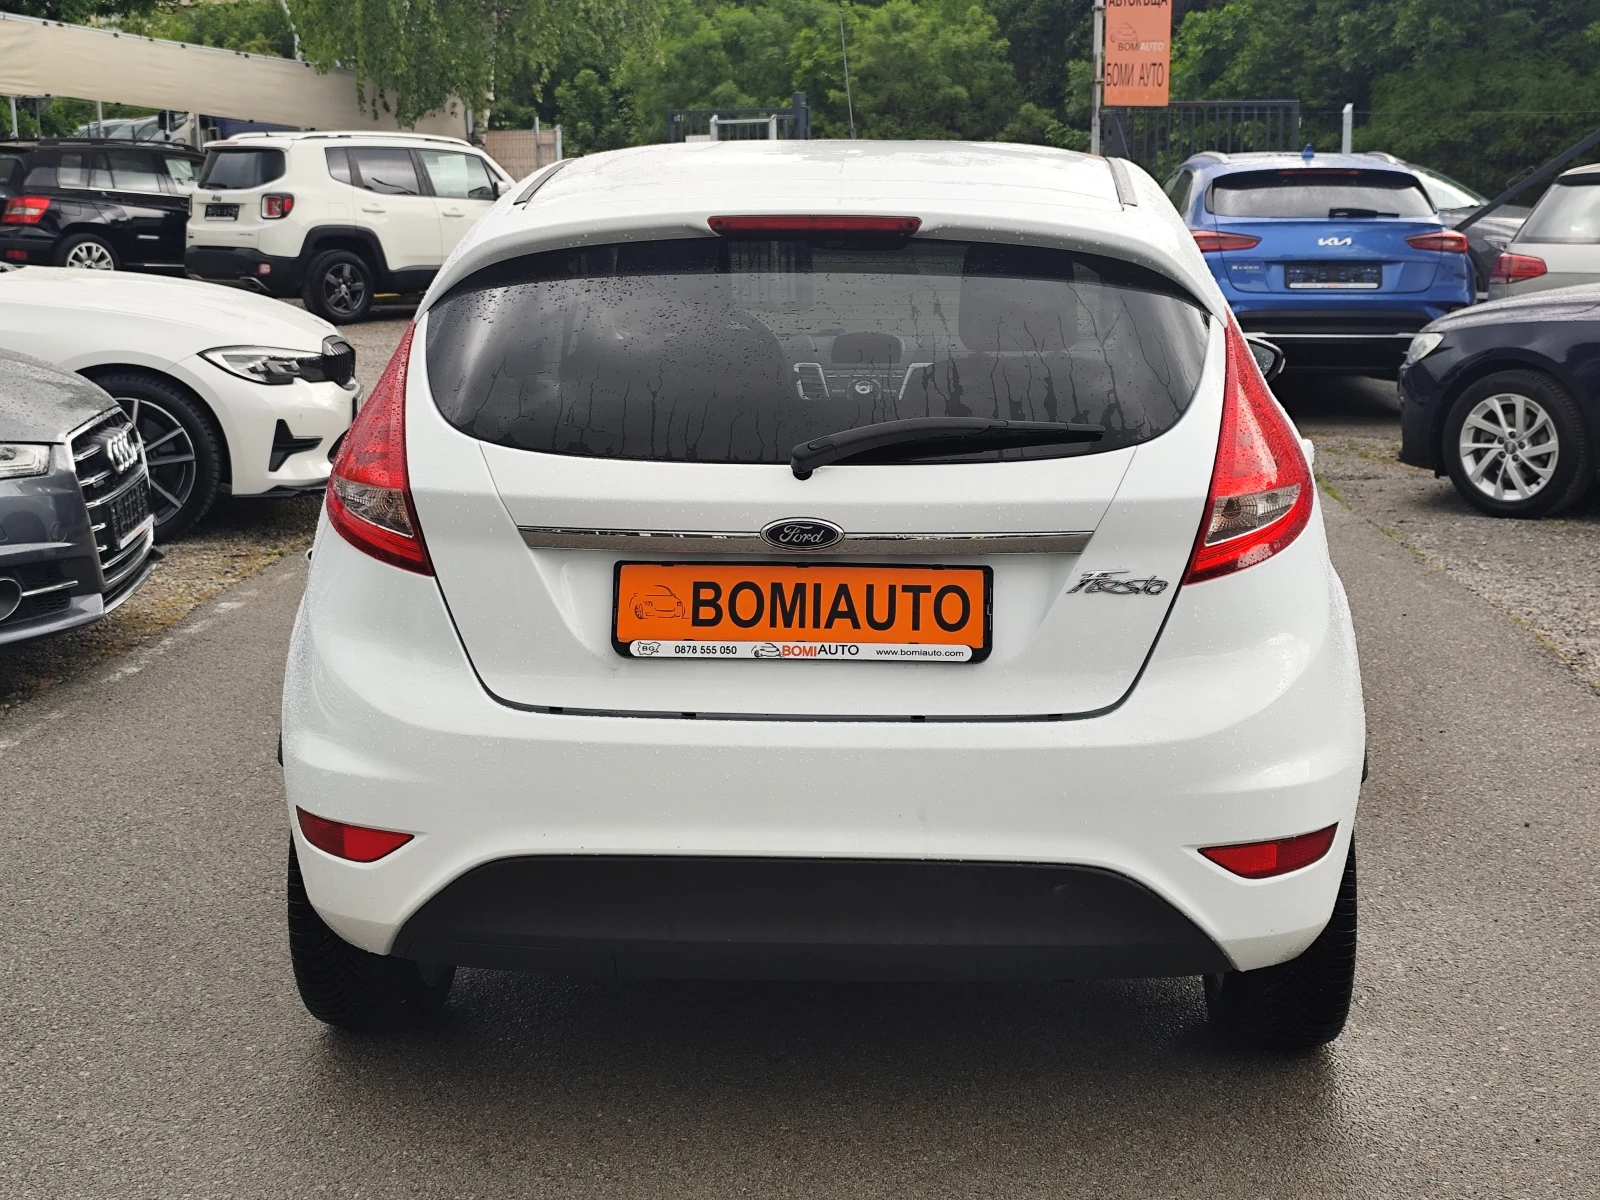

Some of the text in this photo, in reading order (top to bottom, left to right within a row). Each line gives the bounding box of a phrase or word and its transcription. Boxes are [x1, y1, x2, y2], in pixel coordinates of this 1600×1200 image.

[1106, 63, 1164, 87] БОМИ АУТО
[1317, 236, 1352, 246] KIA
[779, 524, 825, 543] Ford
[1065, 569, 1170, 595] Fiesta
[691, 581, 971, 632] BOMIAUTO
[674, 645, 738, 655] 0878 555 050
[875, 648, 965, 657] www.bomiauto.com
